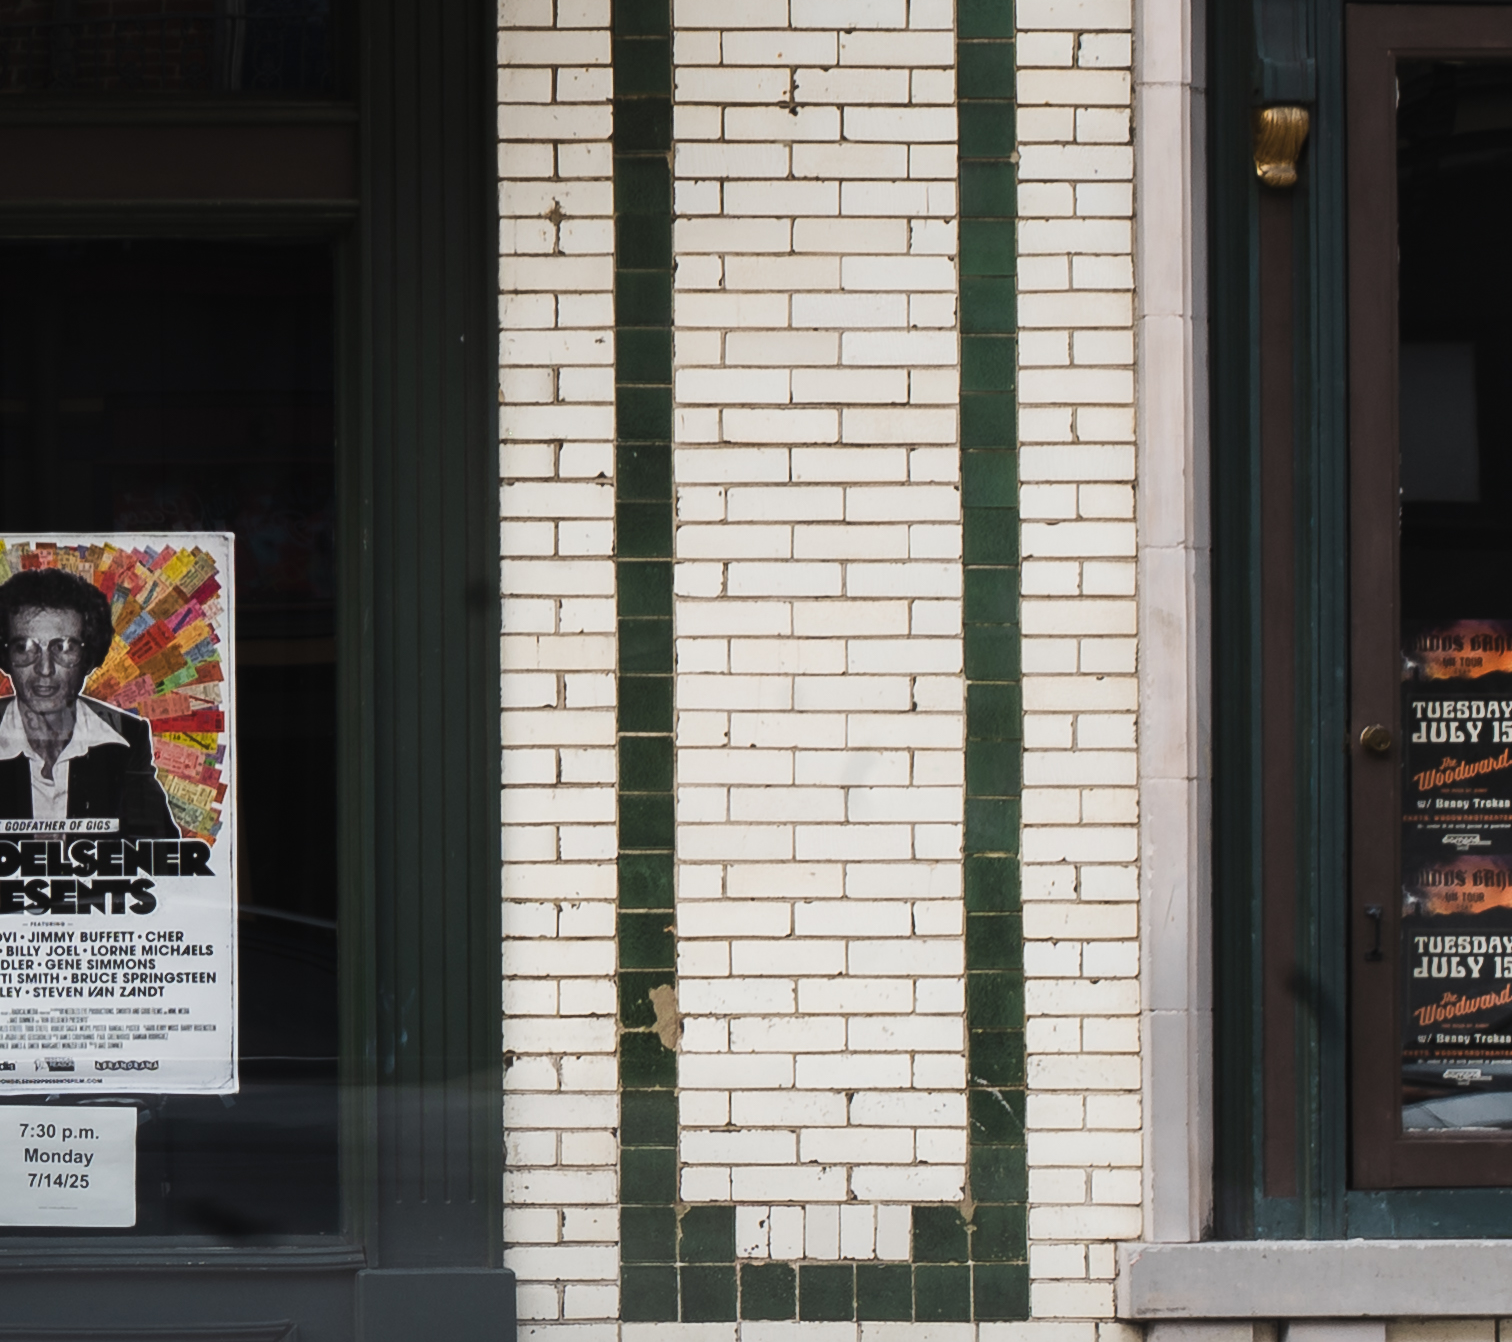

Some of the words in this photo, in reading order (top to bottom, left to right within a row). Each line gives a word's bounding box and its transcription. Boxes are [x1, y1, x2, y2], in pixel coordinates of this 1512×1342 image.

[1413, 701, 1512, 718] TUESDAY
[1412, 721, 1482, 743] JULY
[1413, 748, 1512, 791] Woodward
[1439, 757, 1457, 769] The
[4, 820, 67, 832] GODFATHER
[69, 820, 83, 831] OF
[86, 819, 111, 831] GIGS
[28, 931, 75, 943] JIMMY
[80, 931, 135, 943] BUFFETT
[145, 931, 184, 943] CHER
[1415, 936, 1512, 953] TUESDAY
[7, 945, 41, 957] BILLY
[45, 945, 80, 957] JOEL
[91, 945, 136, 957] LORNE
[141, 945, 213, 957] MICHAELS
[45, 959, 82, 970] GENE
[87, 959, 156, 970] SIMMONS
[1414, 956, 1484, 978] JULY
[17, 972, 59, 984] SMITH
[71, 972, 118, 984] BRUCE
[123, 972, 216, 984] SPRINGSTEEN
[33, 986, 83, 998] STEVEN
[88, 986, 114, 998] VAN
[119, 986, 165, 998] ZANDT
[1441, 992, 1459, 1004] The
[1415, 983, 1512, 1026] Woodward
[19, 1123, 56, 1138] 7:30
[62, 1127, 99, 1142] p.m.
[24, 1148, 94, 1167] Monday
[28, 1173, 90, 1189] 7/14/25
